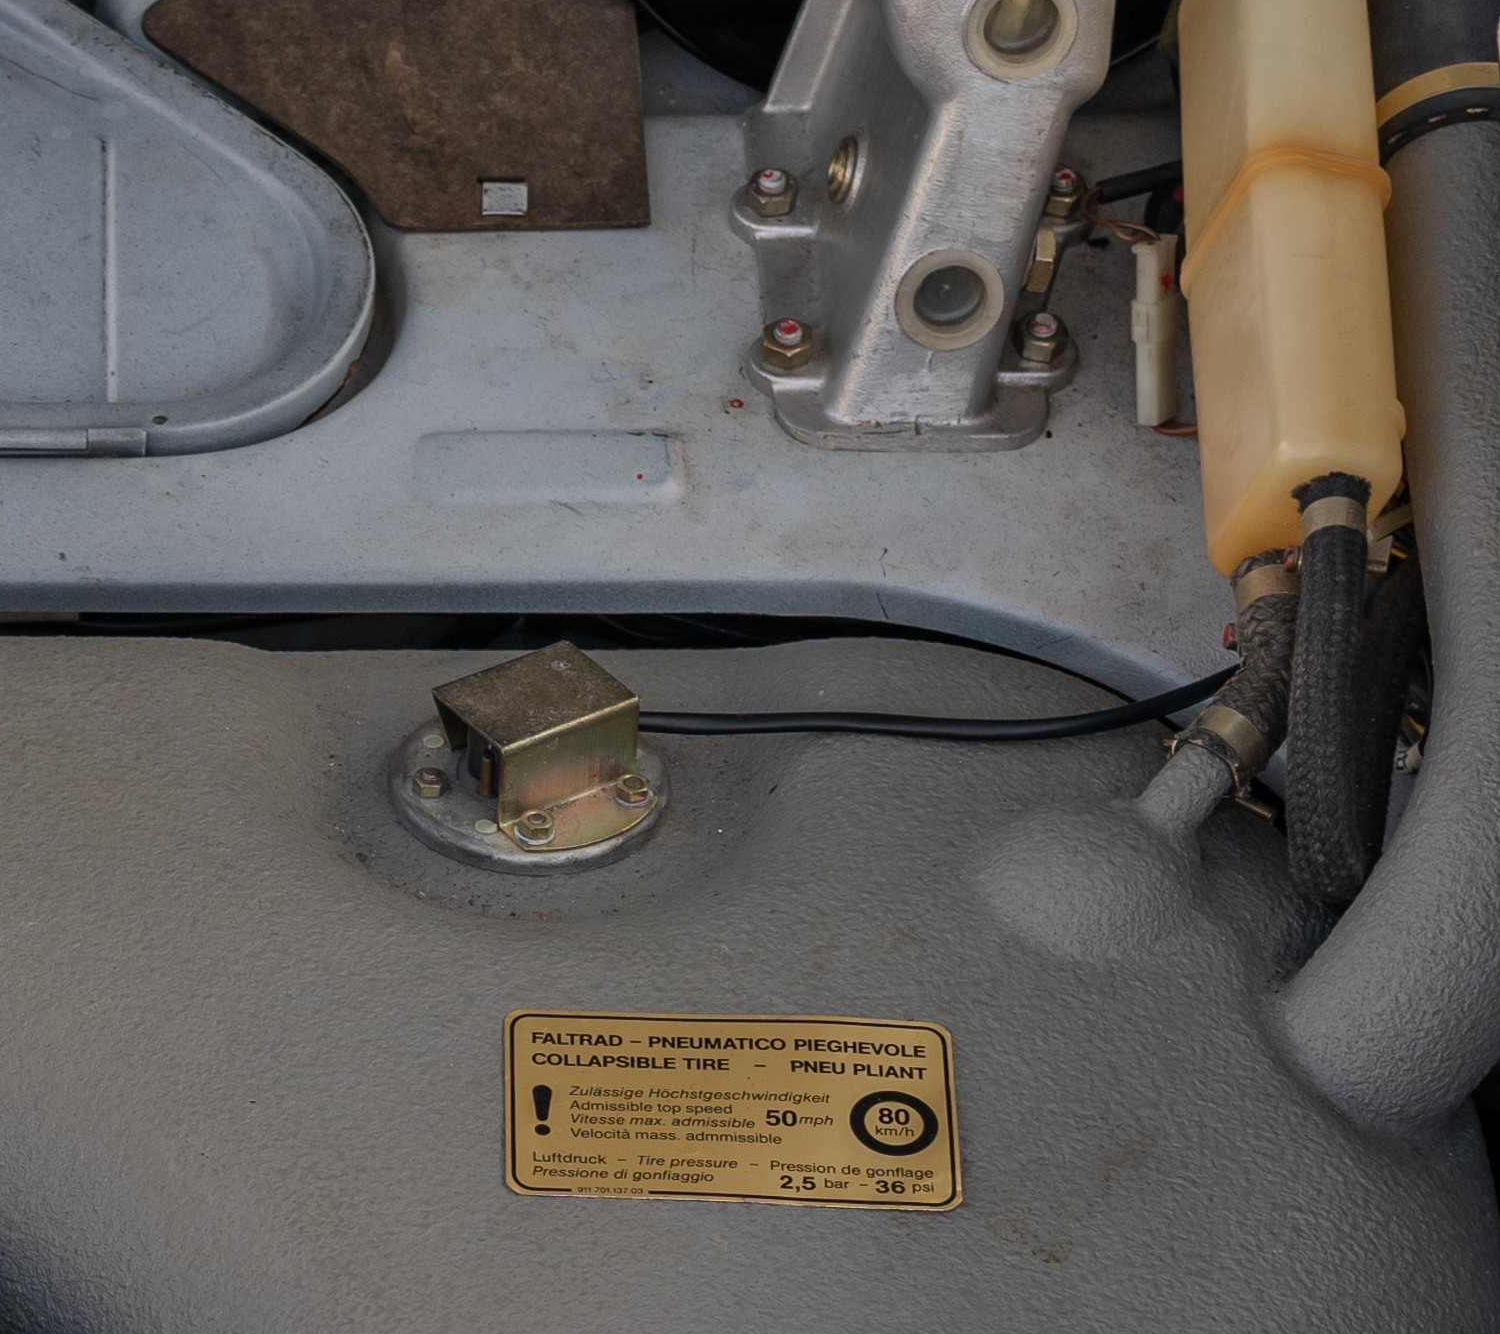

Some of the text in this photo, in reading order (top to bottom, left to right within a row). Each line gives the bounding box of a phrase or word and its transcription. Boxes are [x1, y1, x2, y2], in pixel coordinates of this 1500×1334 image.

[532, 1032, 622, 1046] FALTRAD
[648, 1035, 786, 1051] PNEUMATICO
[794, 1039, 926, 1058] PIEGHEVOLE
[532, 1053, 676, 1070] COLLAPSIBLE
[683, 1057, 730, 1070] TIRE
[790, 1060, 846, 1075] PNEU
[853, 1063, 927, 1080] PLIANT
[569, 1085, 830, 1105] Zulässige Höchstgeschwindigkeit
[570, 1101, 733, 1116] Admissible top speed
[878, 1108, 910, 1125] 80
[570, 1114, 755, 1129] Vitesse max. admissible
[766, 1110, 833, 1127] 50 mph
[570, 1128, 782, 1145] Velocità mass. admmissible
[875, 1124, 914, 1138] km/h
[533, 1152, 607, 1165] Luftdruck
[637, 1155, 666, 1166] Tire
[670, 1158, 738, 1170] pressure
[770, 1160, 836, 1174] Pression
[841, 1162, 861, 1175] de
[866, 1166, 934, 1180] gonflage
[533, 1166, 714, 1183] Pressione di gonfiaggio
[780, 1175, 816, 1193] 2,5
[824, 1178, 849, 1189] bar
[875, 1181, 906, 1195] 36
[912, 1181, 935, 1193] psi
